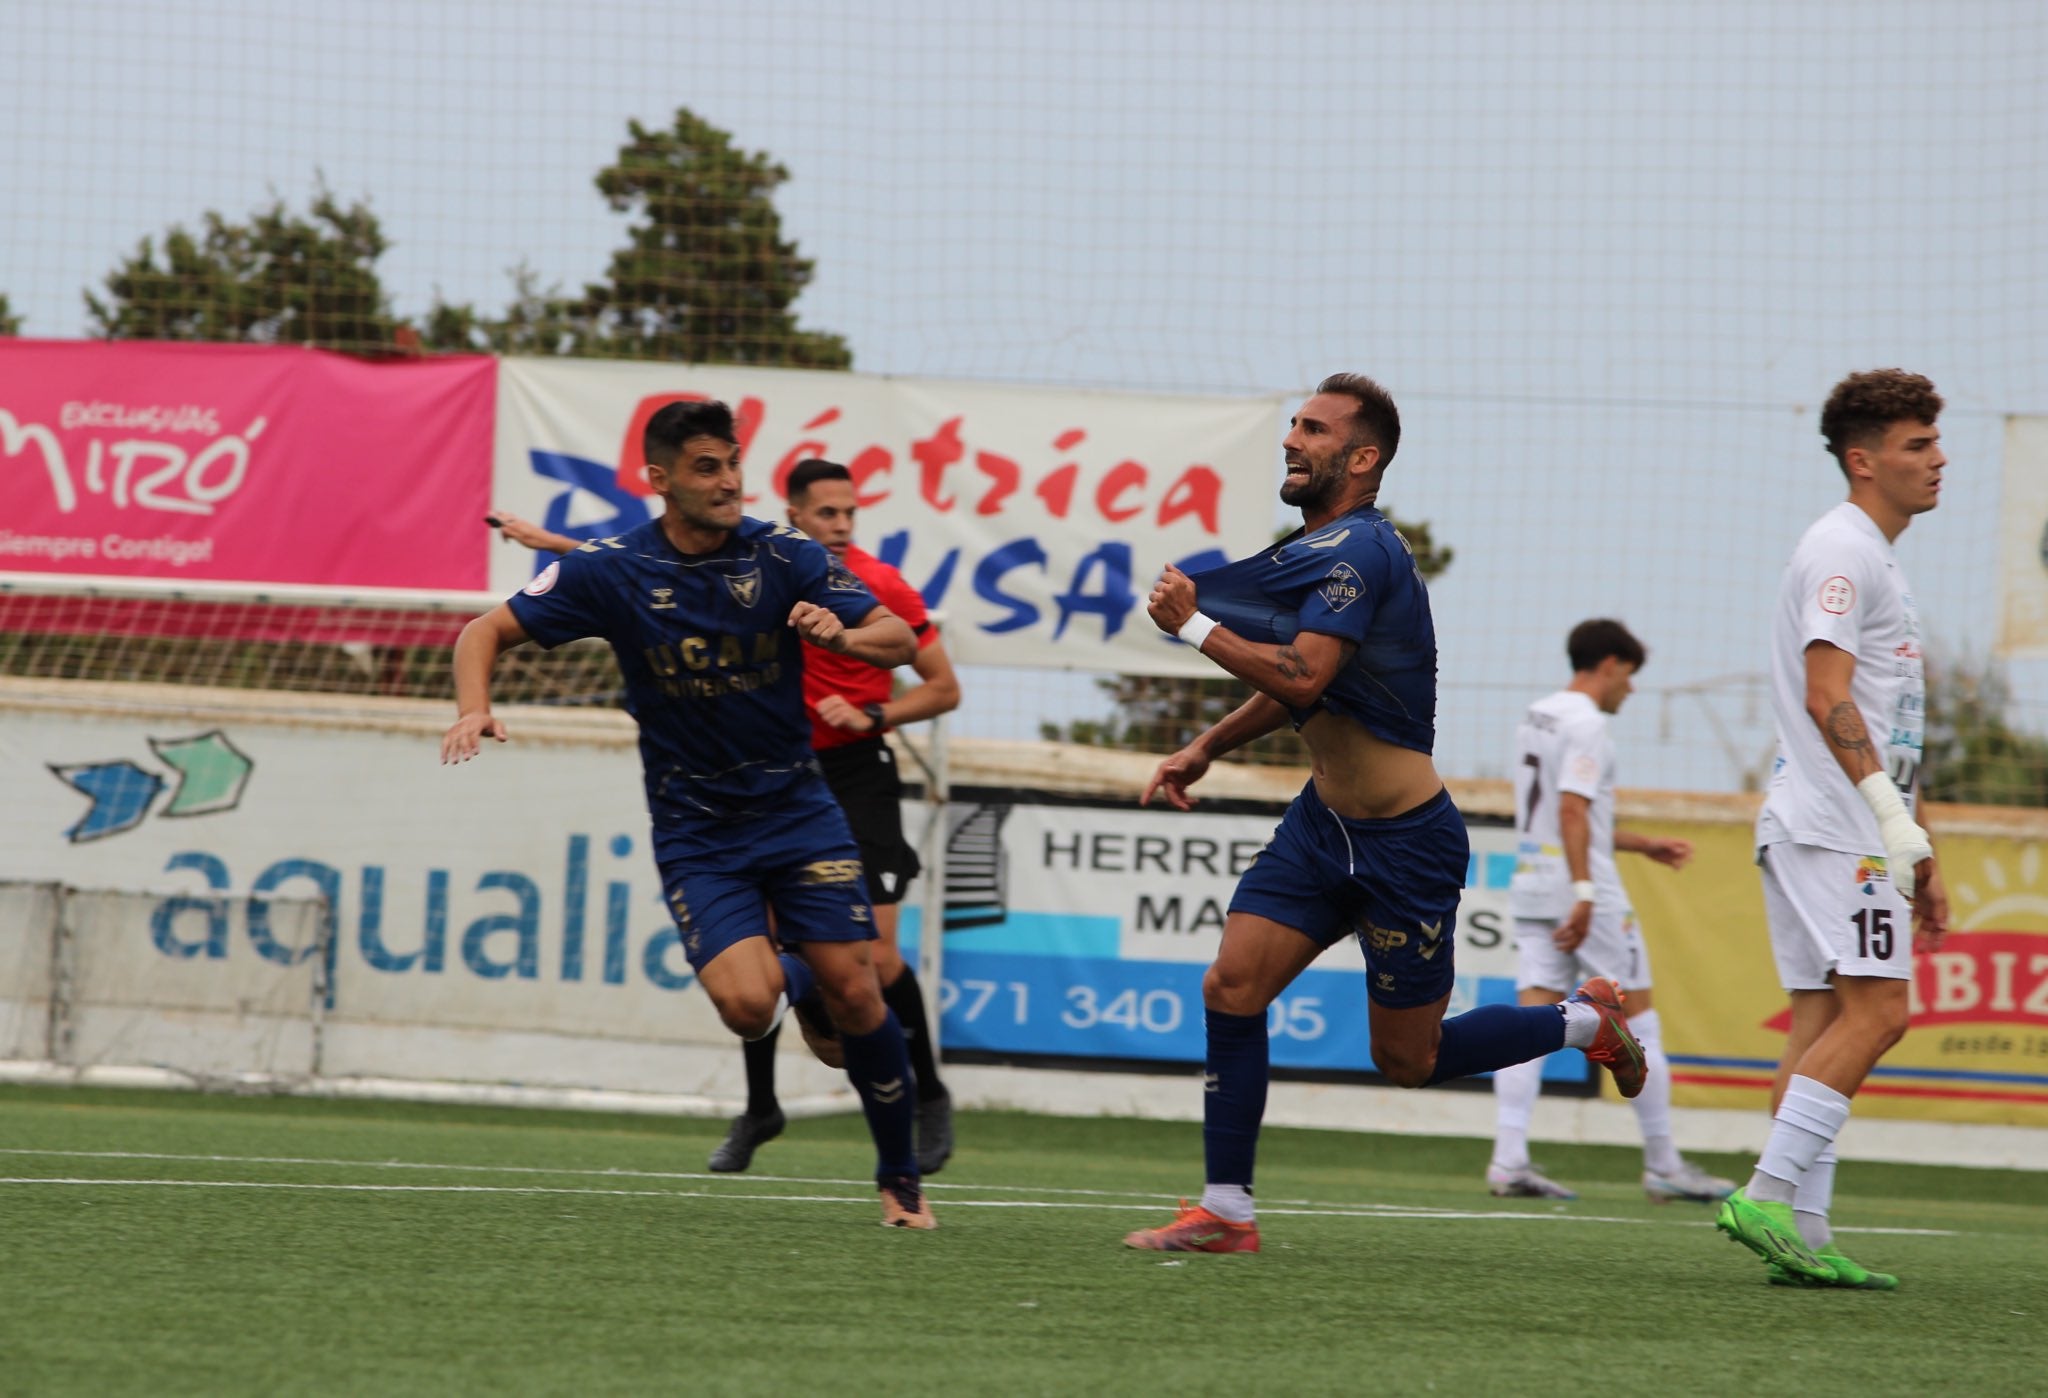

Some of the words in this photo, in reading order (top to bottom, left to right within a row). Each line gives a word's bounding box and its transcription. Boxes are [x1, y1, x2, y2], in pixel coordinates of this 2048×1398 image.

[1326, 583, 1356, 598] Niña
[643, 630, 782, 677] UCAM
[1850, 908, 1894, 960] 15
[1061, 985, 1183, 1033] 340
